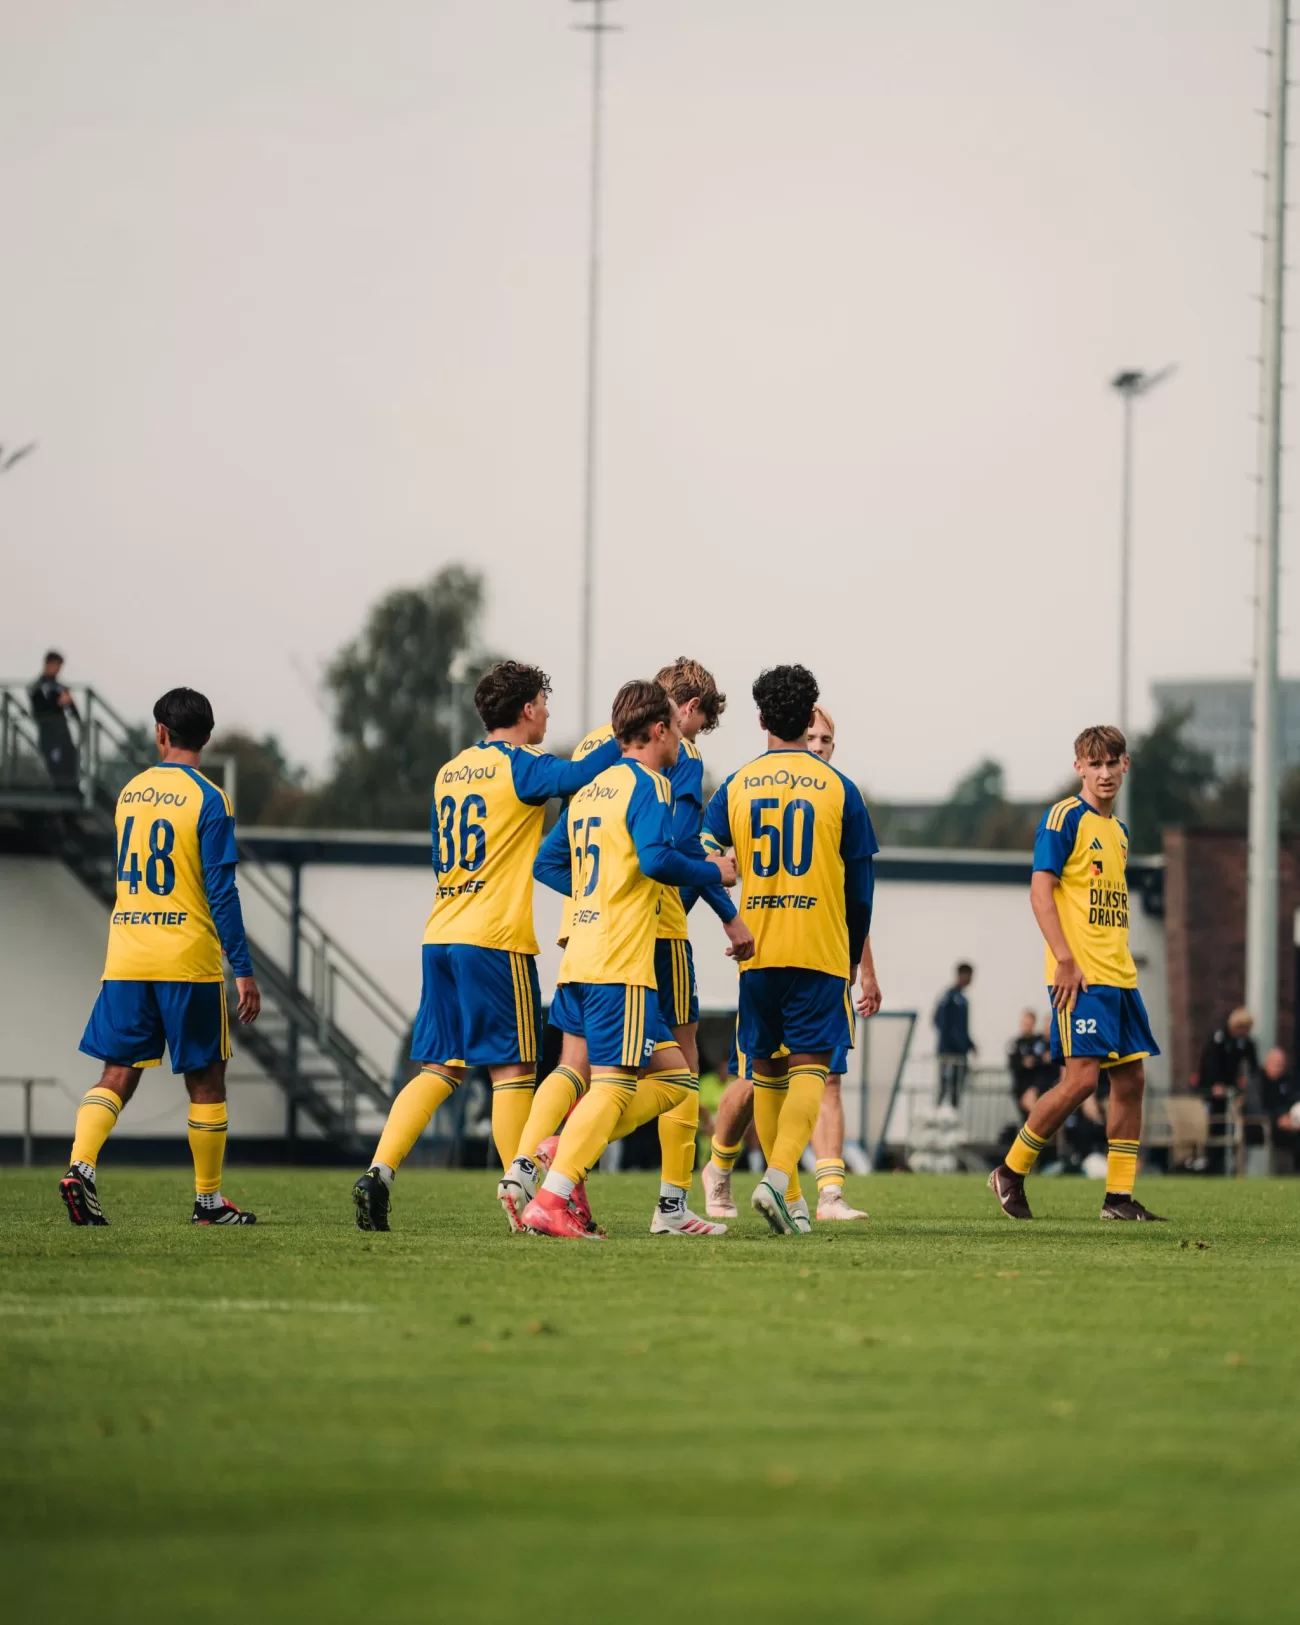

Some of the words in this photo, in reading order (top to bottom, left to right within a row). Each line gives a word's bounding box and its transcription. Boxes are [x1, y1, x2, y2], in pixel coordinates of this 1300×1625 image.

[744, 770, 827, 790] tanQyou
[439, 794, 487, 873] 36
[750, 798, 815, 877] 50
[117, 816, 176, 896] 48
[746, 895, 818, 909] EFFEKTIEF
[1088, 907, 1129, 929] DRAISM
[1075, 1018, 1097, 1035] 32
